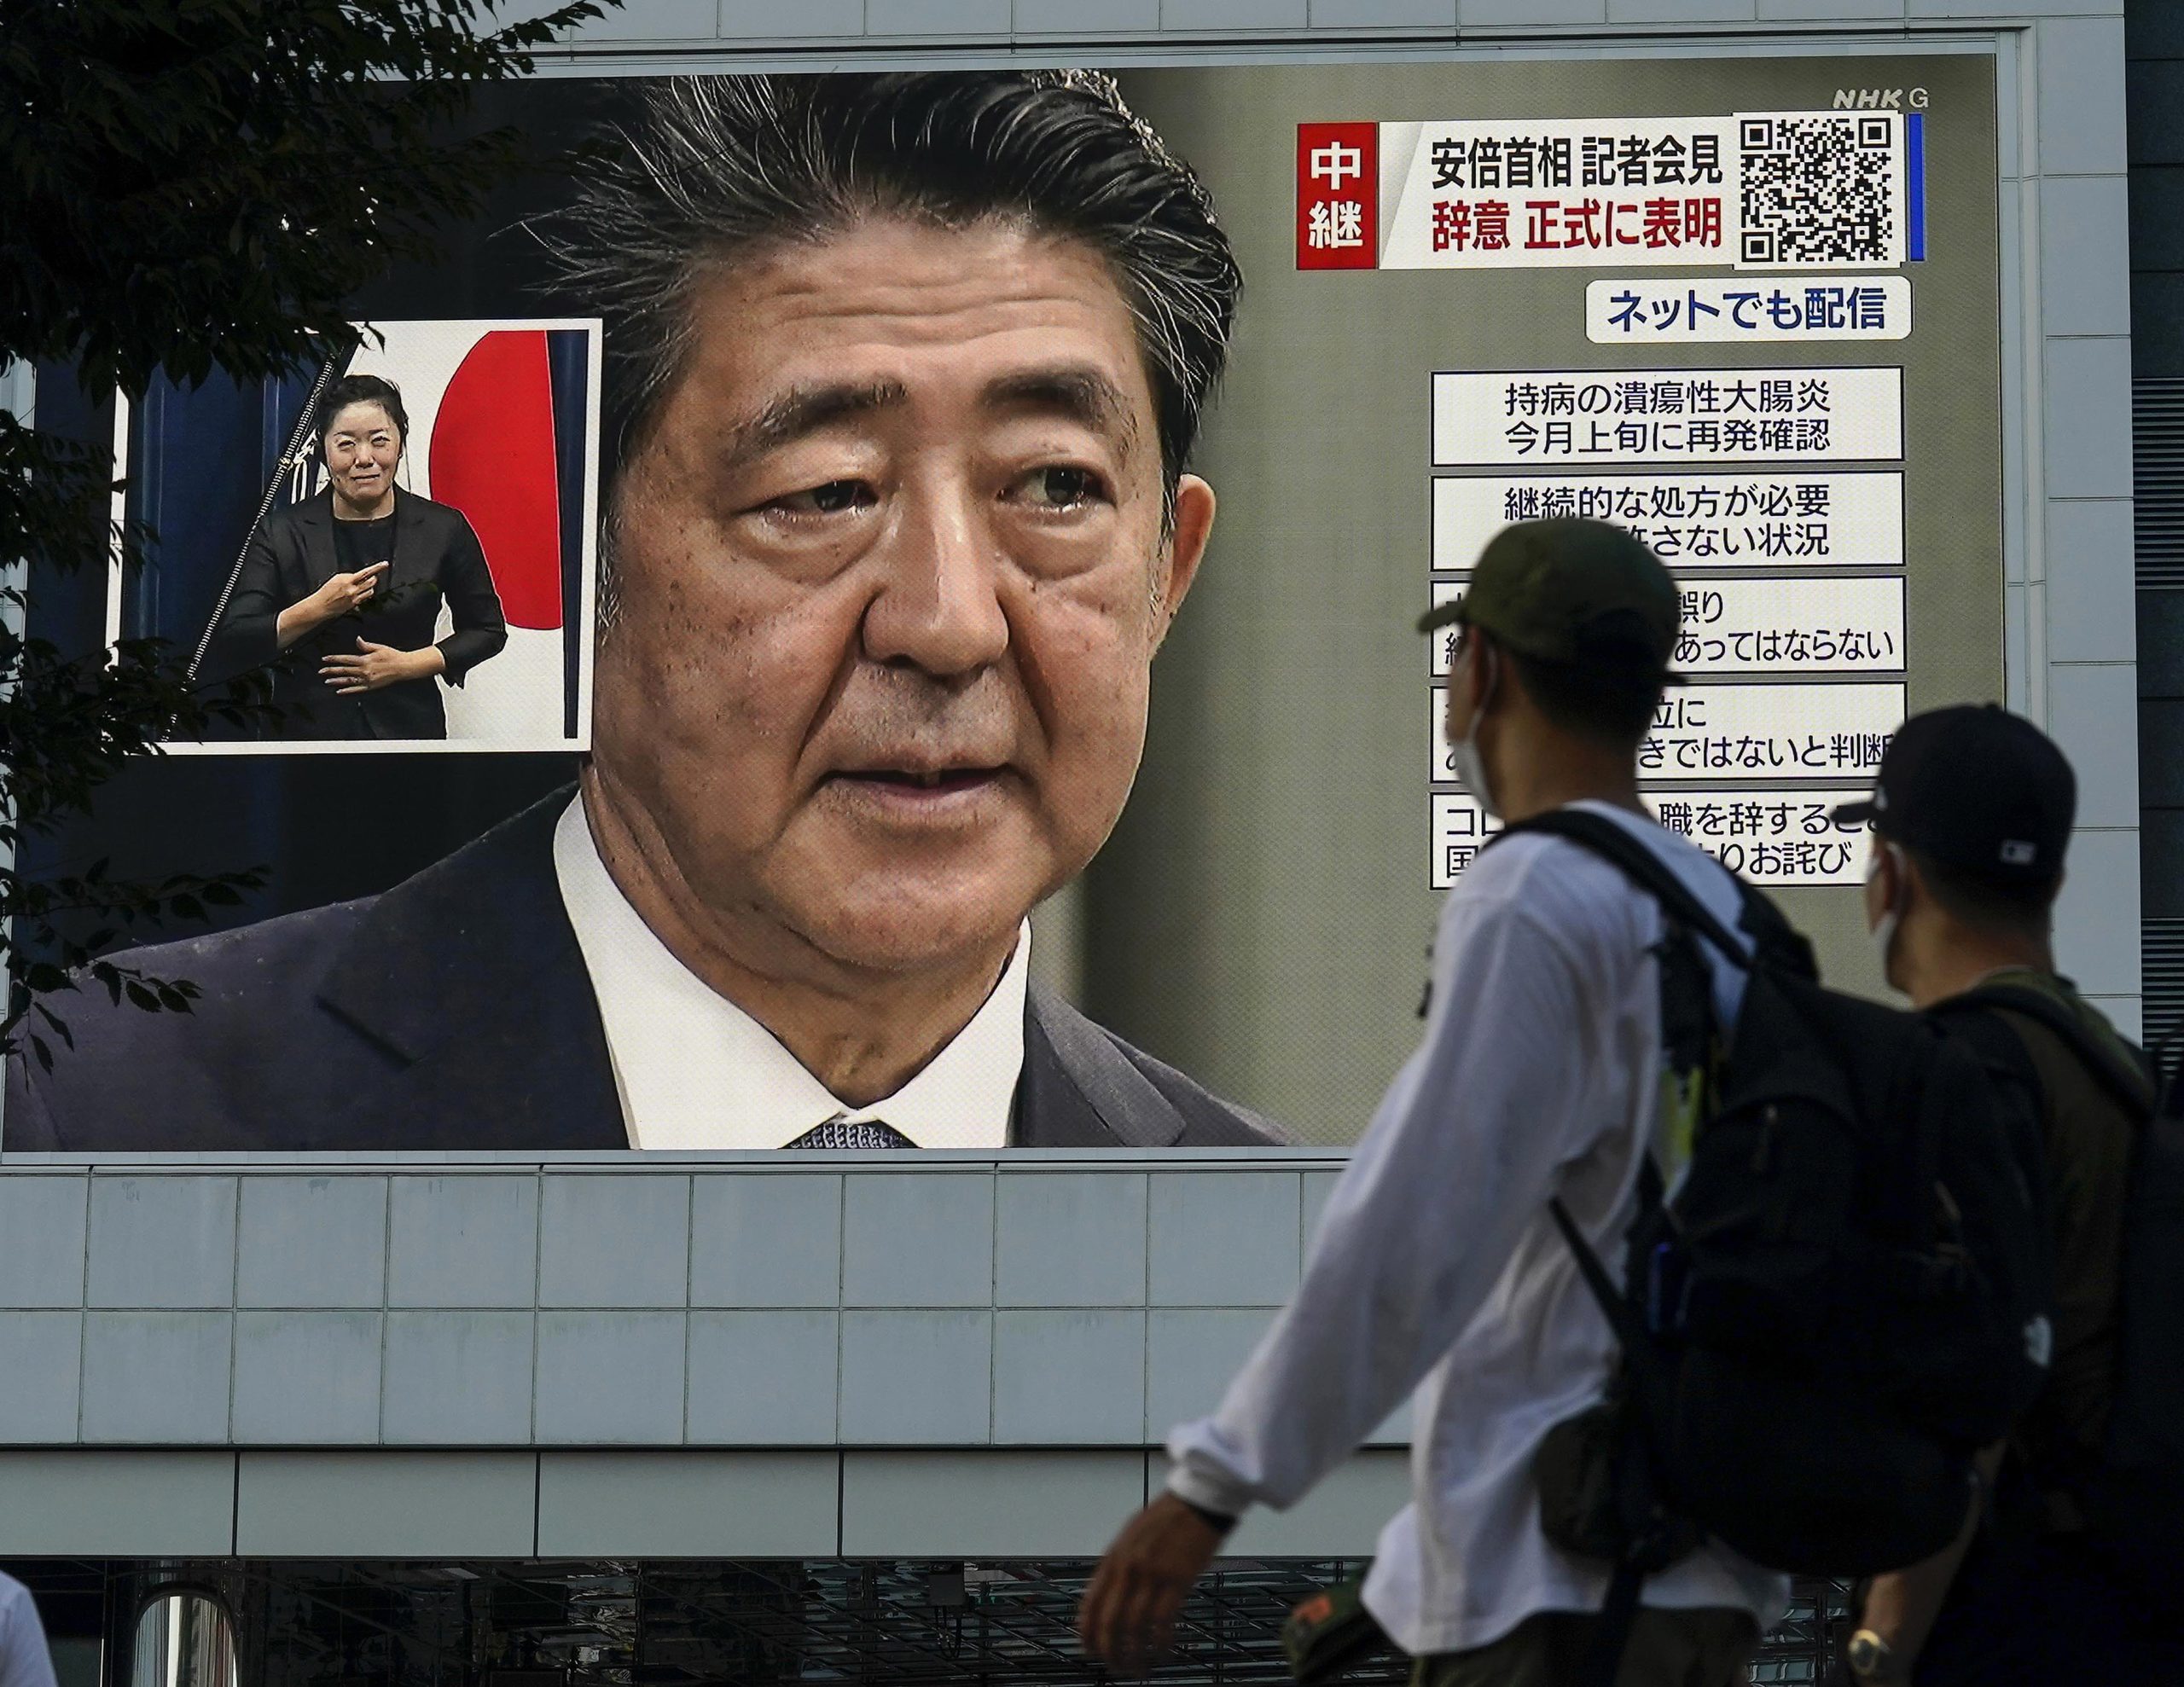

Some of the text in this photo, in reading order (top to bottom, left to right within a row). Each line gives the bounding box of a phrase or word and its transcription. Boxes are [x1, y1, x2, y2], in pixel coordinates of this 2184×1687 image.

[1833, 87, 1929, 109] NHK G
[1431, 134, 1722, 189] 安倍首相 記者会見
[1308, 141, 1363, 250] 中継
[1432, 196, 1722, 252] 辞意 正式に表明
[1607, 286, 1887, 333] ネットでも配信
[1504, 378, 1831, 416] 持病の潰瘍性大腸炎
[1504, 418, 1831, 455] 今月上旬に再発確認
[1504, 482, 1831, 521] 継続的な処方が必要
[1675, 628, 1894, 663] あってはならない
[1638, 732, 1894, 769] きではないと判断
